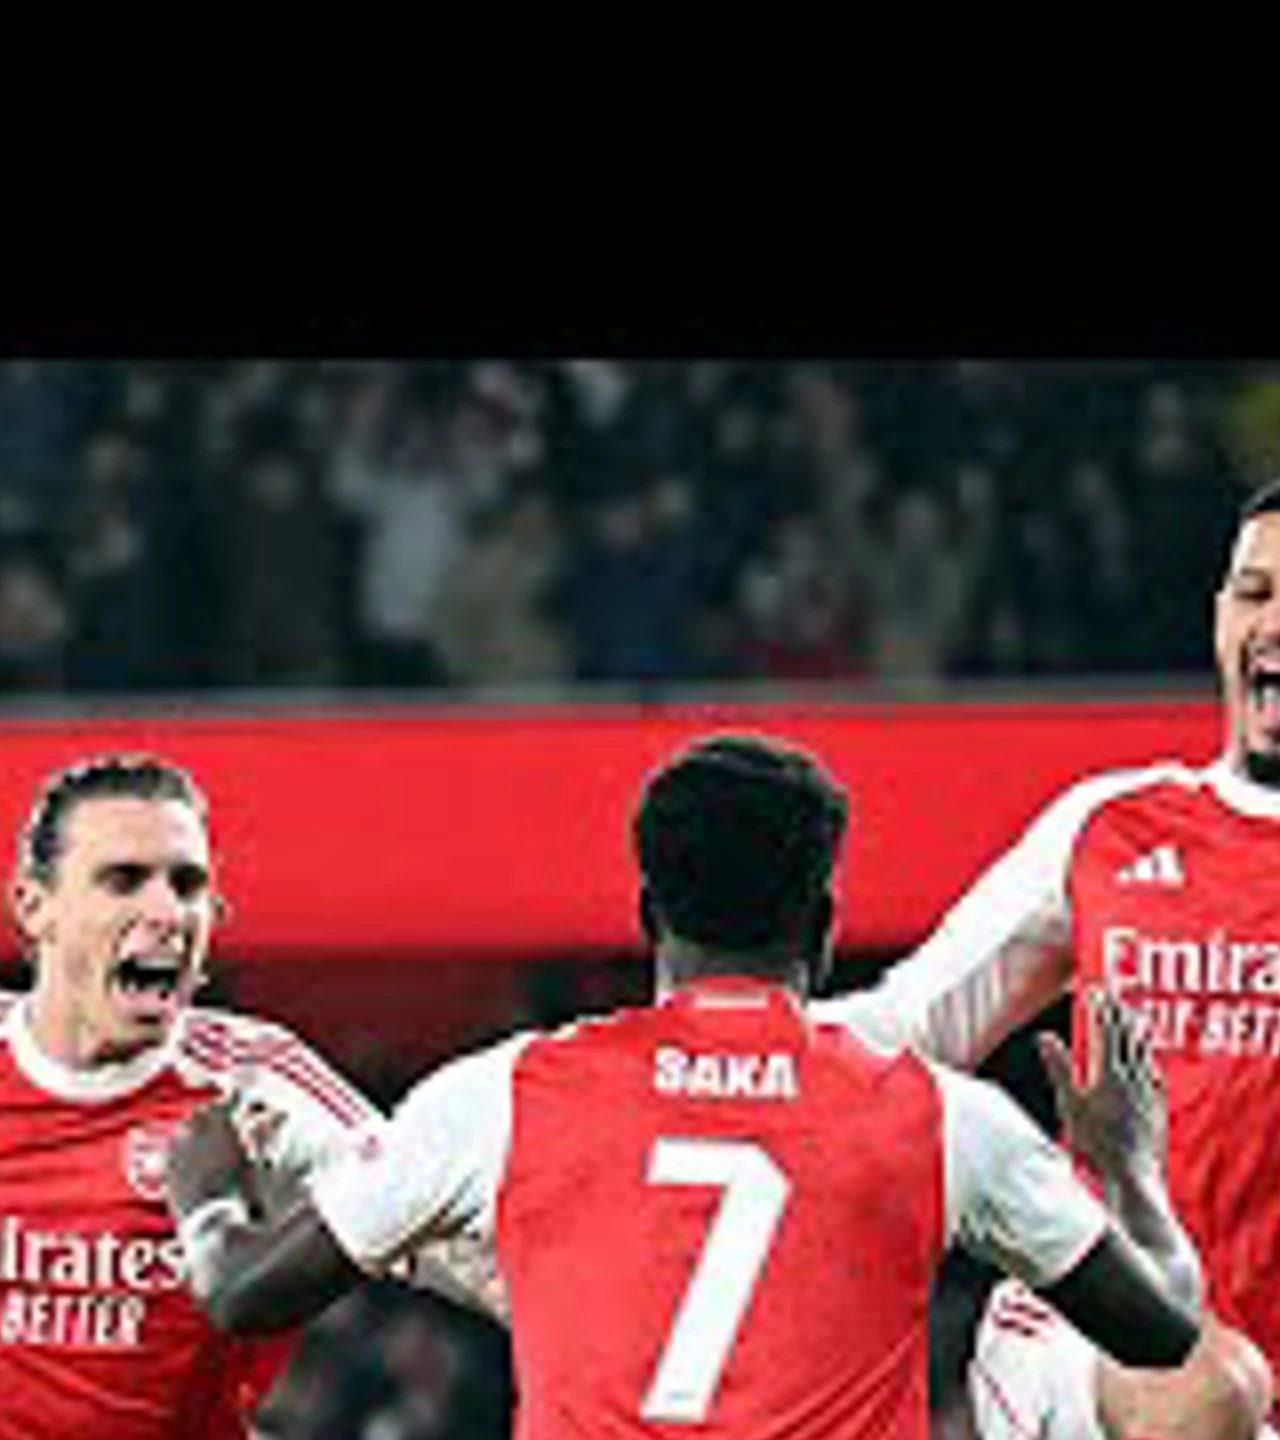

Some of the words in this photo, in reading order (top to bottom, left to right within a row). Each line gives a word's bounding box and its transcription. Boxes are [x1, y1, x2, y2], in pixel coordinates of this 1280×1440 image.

[654, 1045, 798, 1098] SAKA
[640, 1136, 792, 1423] 7
[0, 1293, 146, 1345] BETTER
